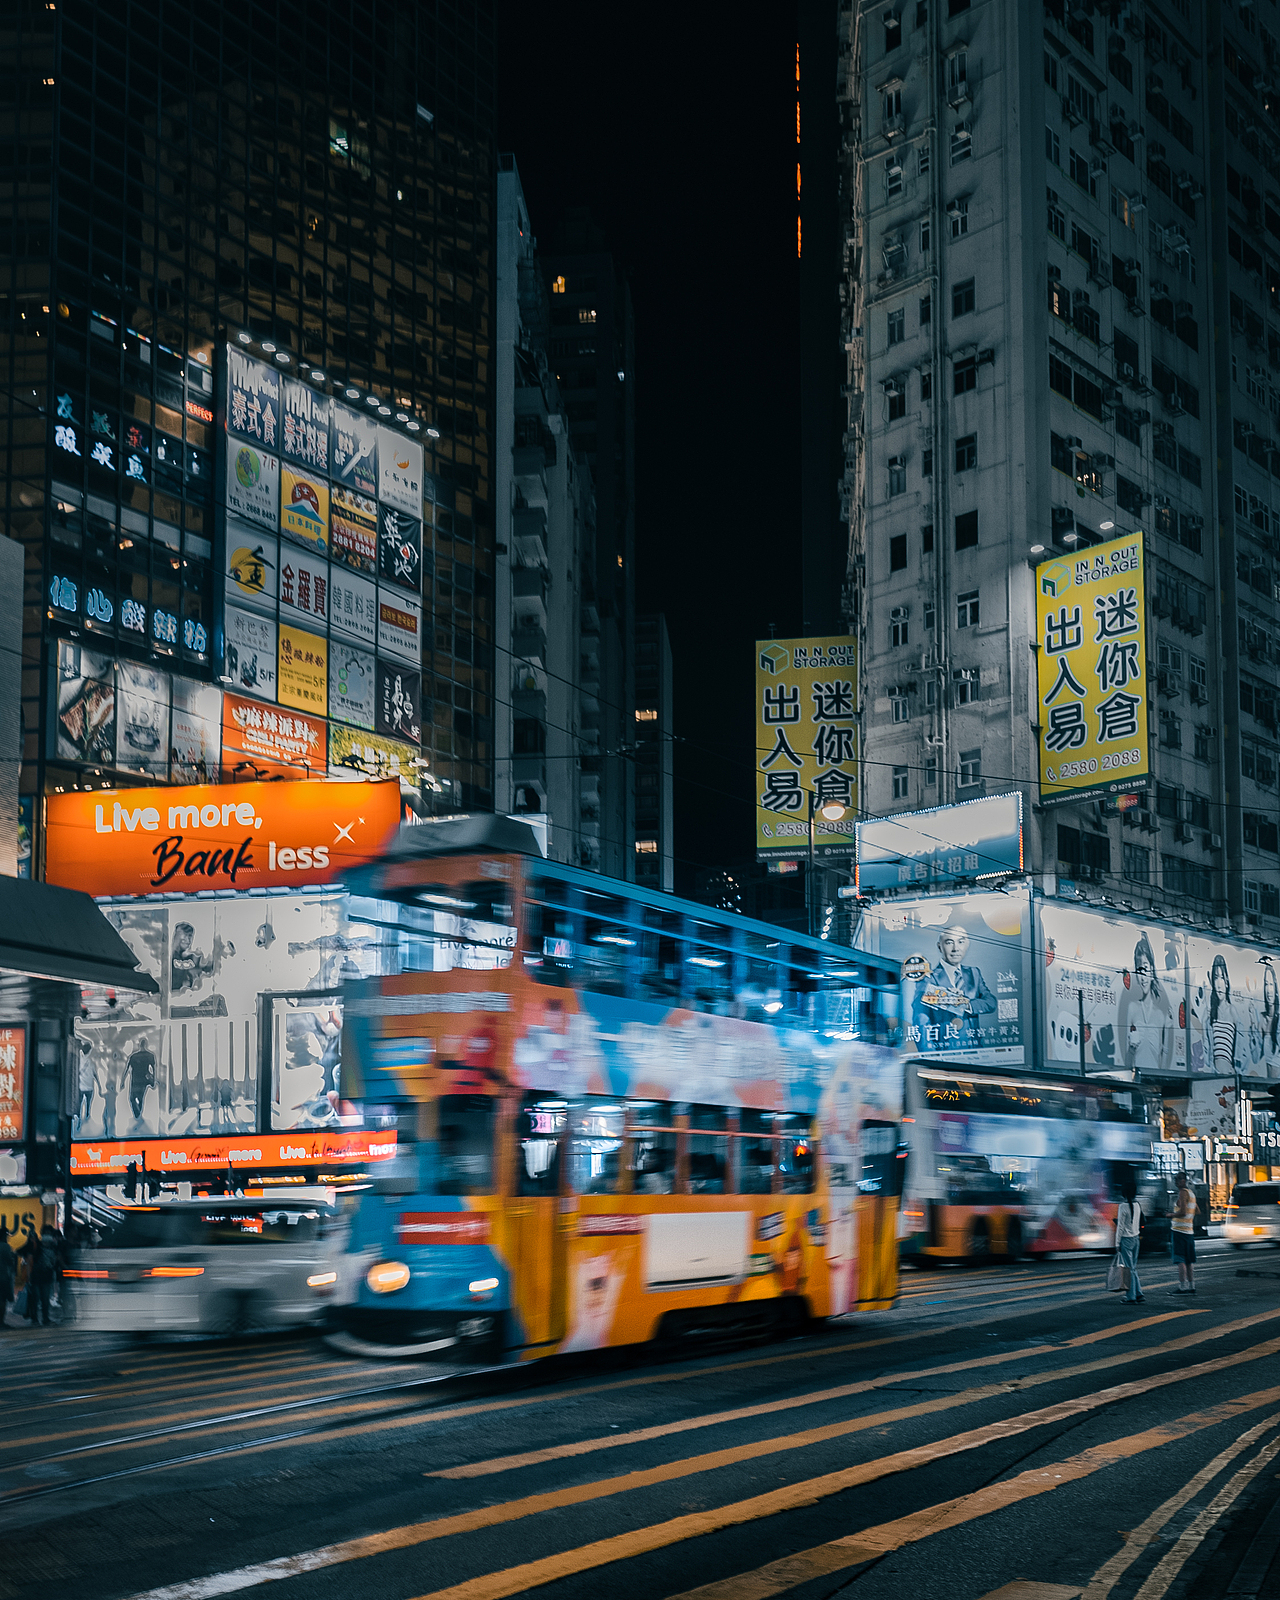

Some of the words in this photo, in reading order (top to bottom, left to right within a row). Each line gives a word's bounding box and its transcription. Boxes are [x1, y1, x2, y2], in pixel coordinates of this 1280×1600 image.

[1075, 558, 1089, 574] IN
[1094, 554, 1105, 568] N
[1110, 544, 1138, 563] OUT
[1075, 557, 1139, 586] STORAGE
[793, 647, 807, 659] IN
[813, 646, 823, 658] N
[828, 645, 855, 658] OUT
[793, 655, 855, 670] STORAGE
[1093, 586, 1144, 746] 迷你倉
[811, 680, 856, 811] 迷你倉
[1059, 757, 1098, 781] 2580
[1101, 748, 1141, 771] 2088
[95, 801, 161, 833] Live
[167, 802, 263, 830] more,
[816, 820, 855, 835] 2088
[149, 835, 254, 887] Bank
[267, 840, 331, 872] less
[898, 854, 980, 882] 廣告位招租
[905, 1022, 961, 1043] 馬百良
